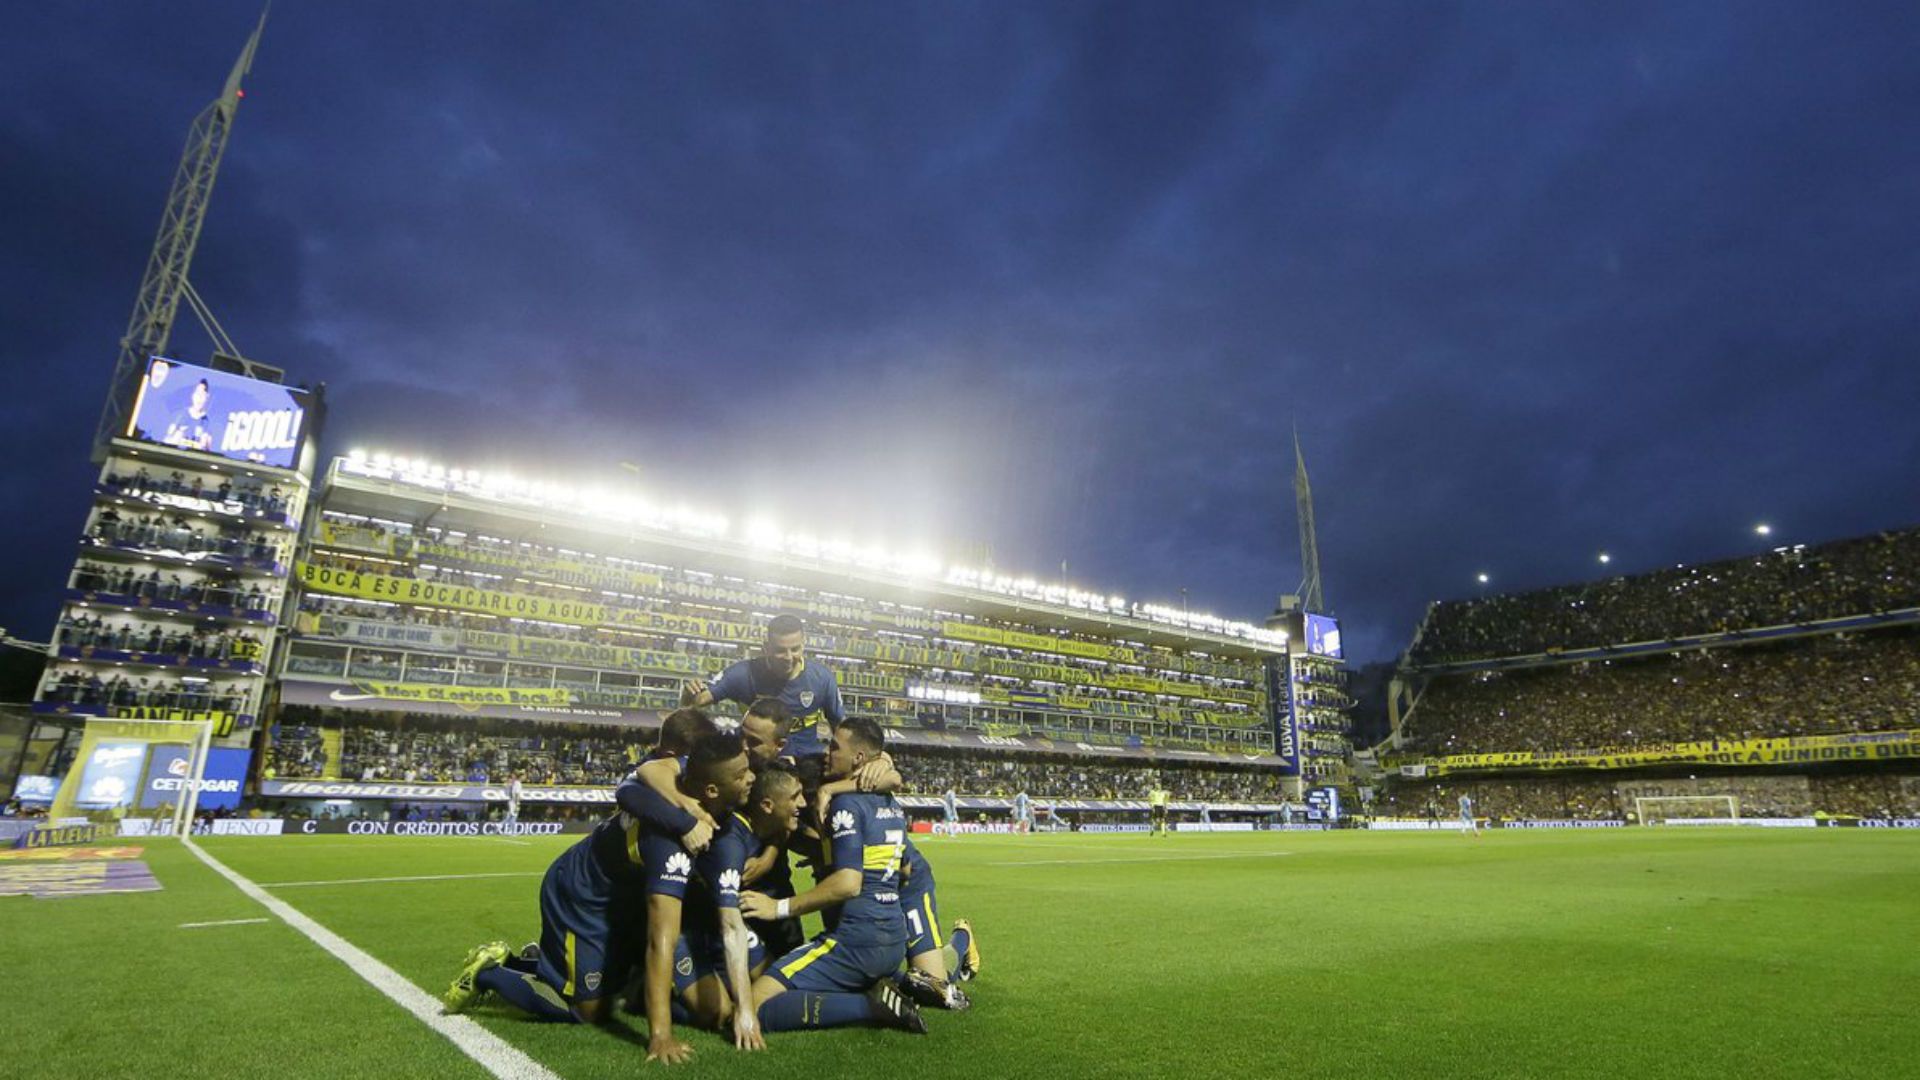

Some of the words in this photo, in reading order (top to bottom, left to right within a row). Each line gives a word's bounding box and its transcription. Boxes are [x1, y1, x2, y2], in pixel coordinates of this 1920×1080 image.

[305, 566, 360, 590] BOCA
[374, 579, 399, 595] ES
[409, 583, 461, 605] BOCA
[466, 588, 539, 614] CARLOS
[548, 602, 605, 622] AGUAS
[650, 614, 700, 633] Boca
[1280, 715, 1295, 757] BBVA
[1772, 745, 1867, 762] JUNIORS
[152, 778, 239, 792] CETROGAR
[348, 821, 388, 835] CON
[883, 830, 904, 882] 7
